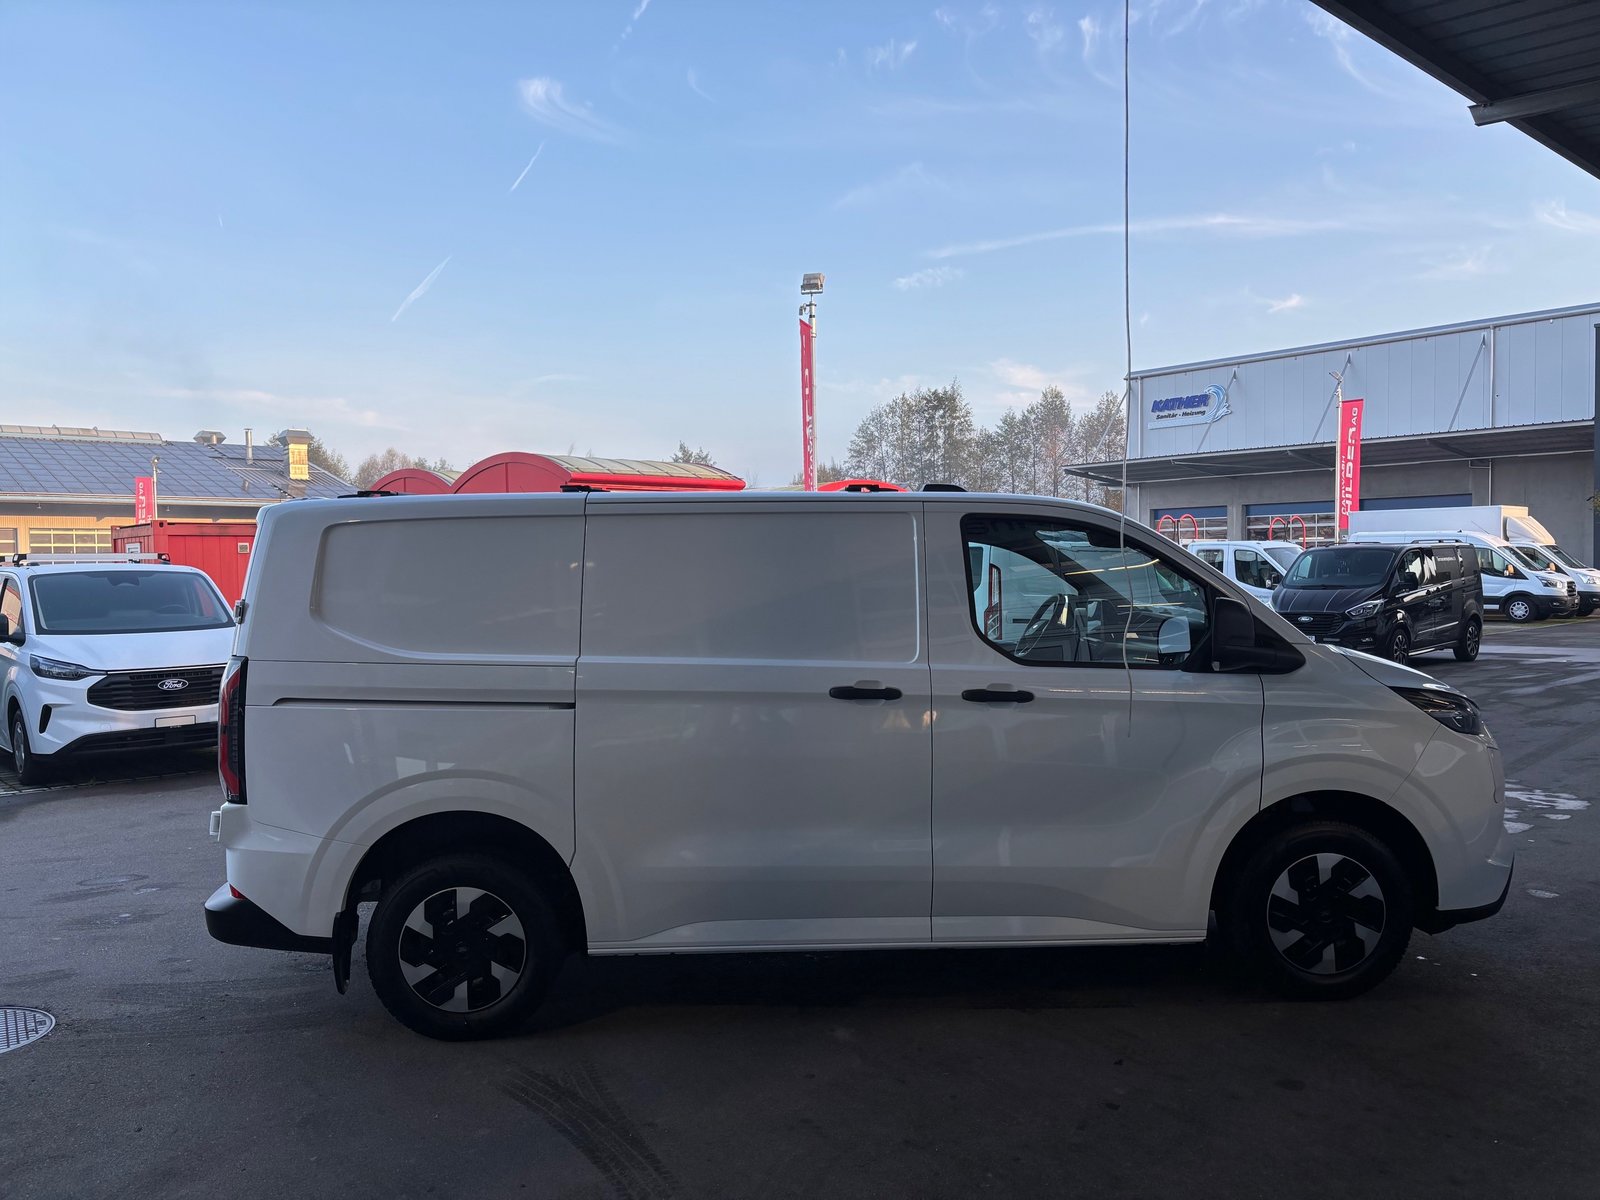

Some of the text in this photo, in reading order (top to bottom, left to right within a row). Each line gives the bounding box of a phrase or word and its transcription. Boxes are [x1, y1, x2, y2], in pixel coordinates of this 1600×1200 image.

[1151, 393, 1211, 413] KATHER
[1156, 412, 1178, 420] Sanitär
[1351, 407, 1358, 426] AG
[162, 680, 183, 689] Ford
